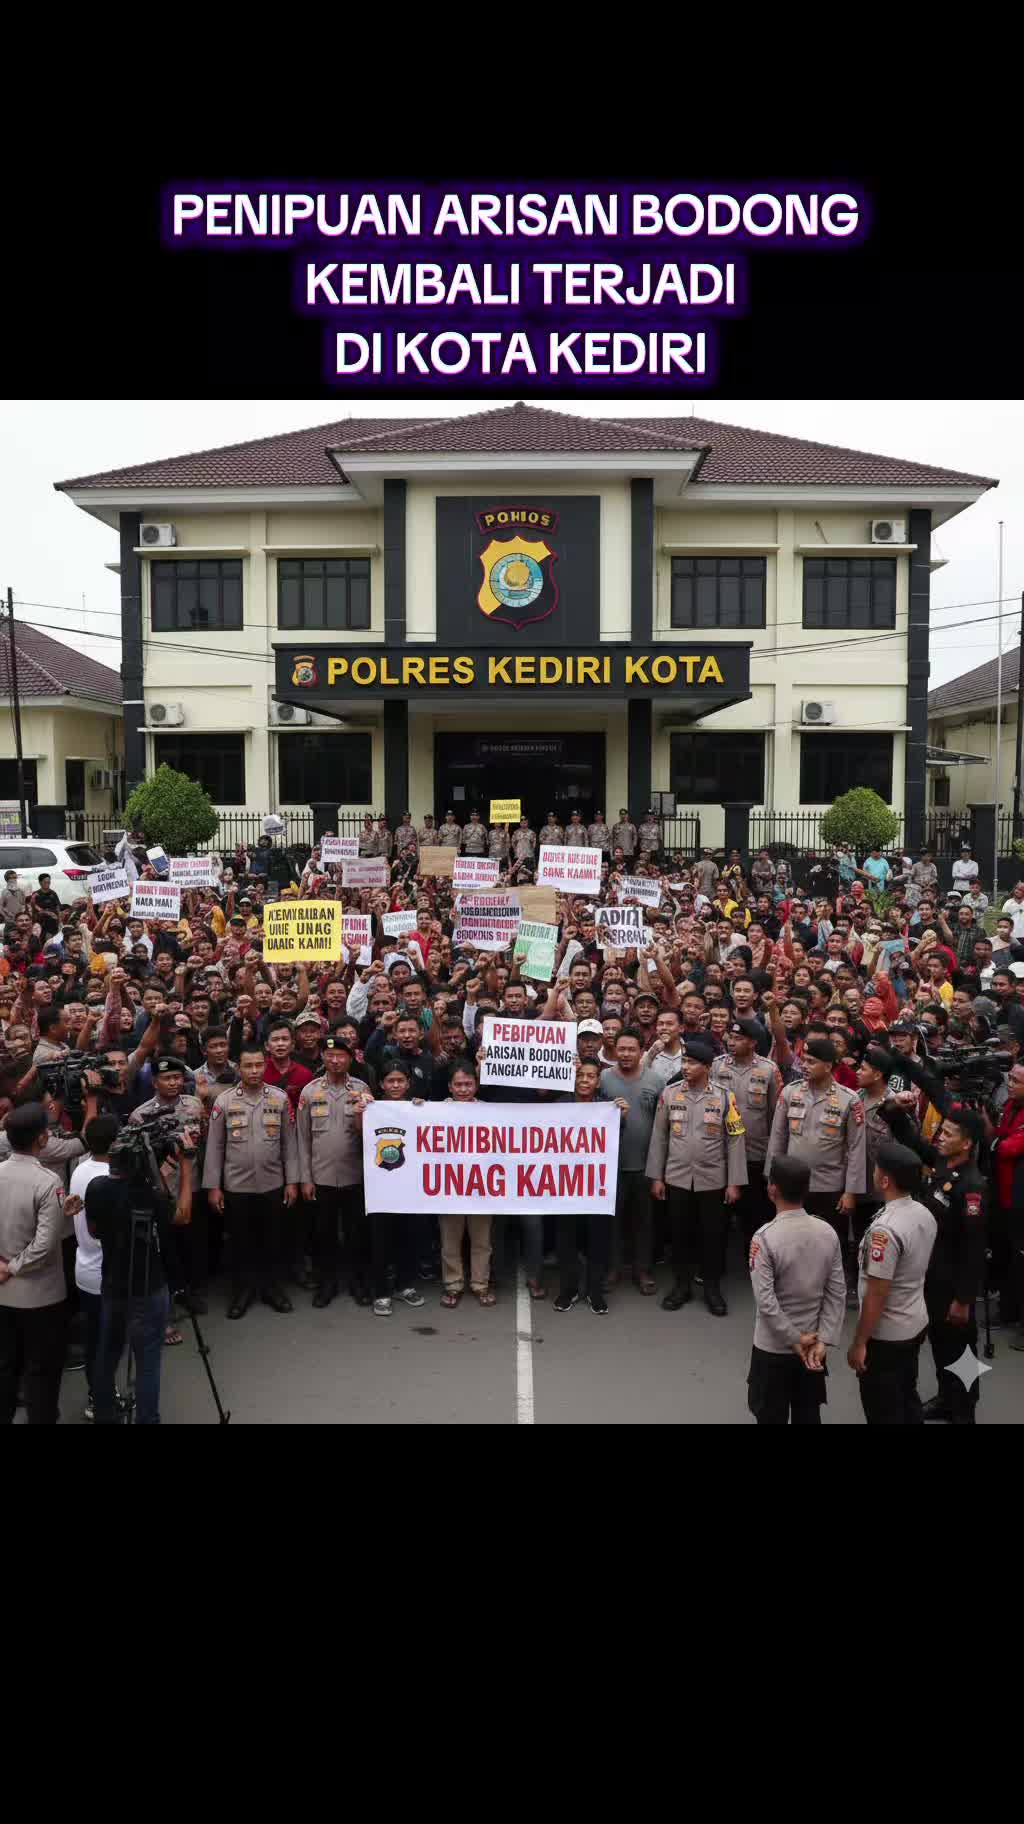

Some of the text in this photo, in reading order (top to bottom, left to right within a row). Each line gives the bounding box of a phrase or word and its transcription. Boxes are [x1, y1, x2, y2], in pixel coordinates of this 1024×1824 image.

[327, 655, 725, 686] POLRES KEDIRI KOTA
[493, 1023, 566, 1044] PEBIPUAN
[486, 1045, 572, 1064] ARISAN BODONG
[422, 1163, 608, 1198] UNAG KAMI!
